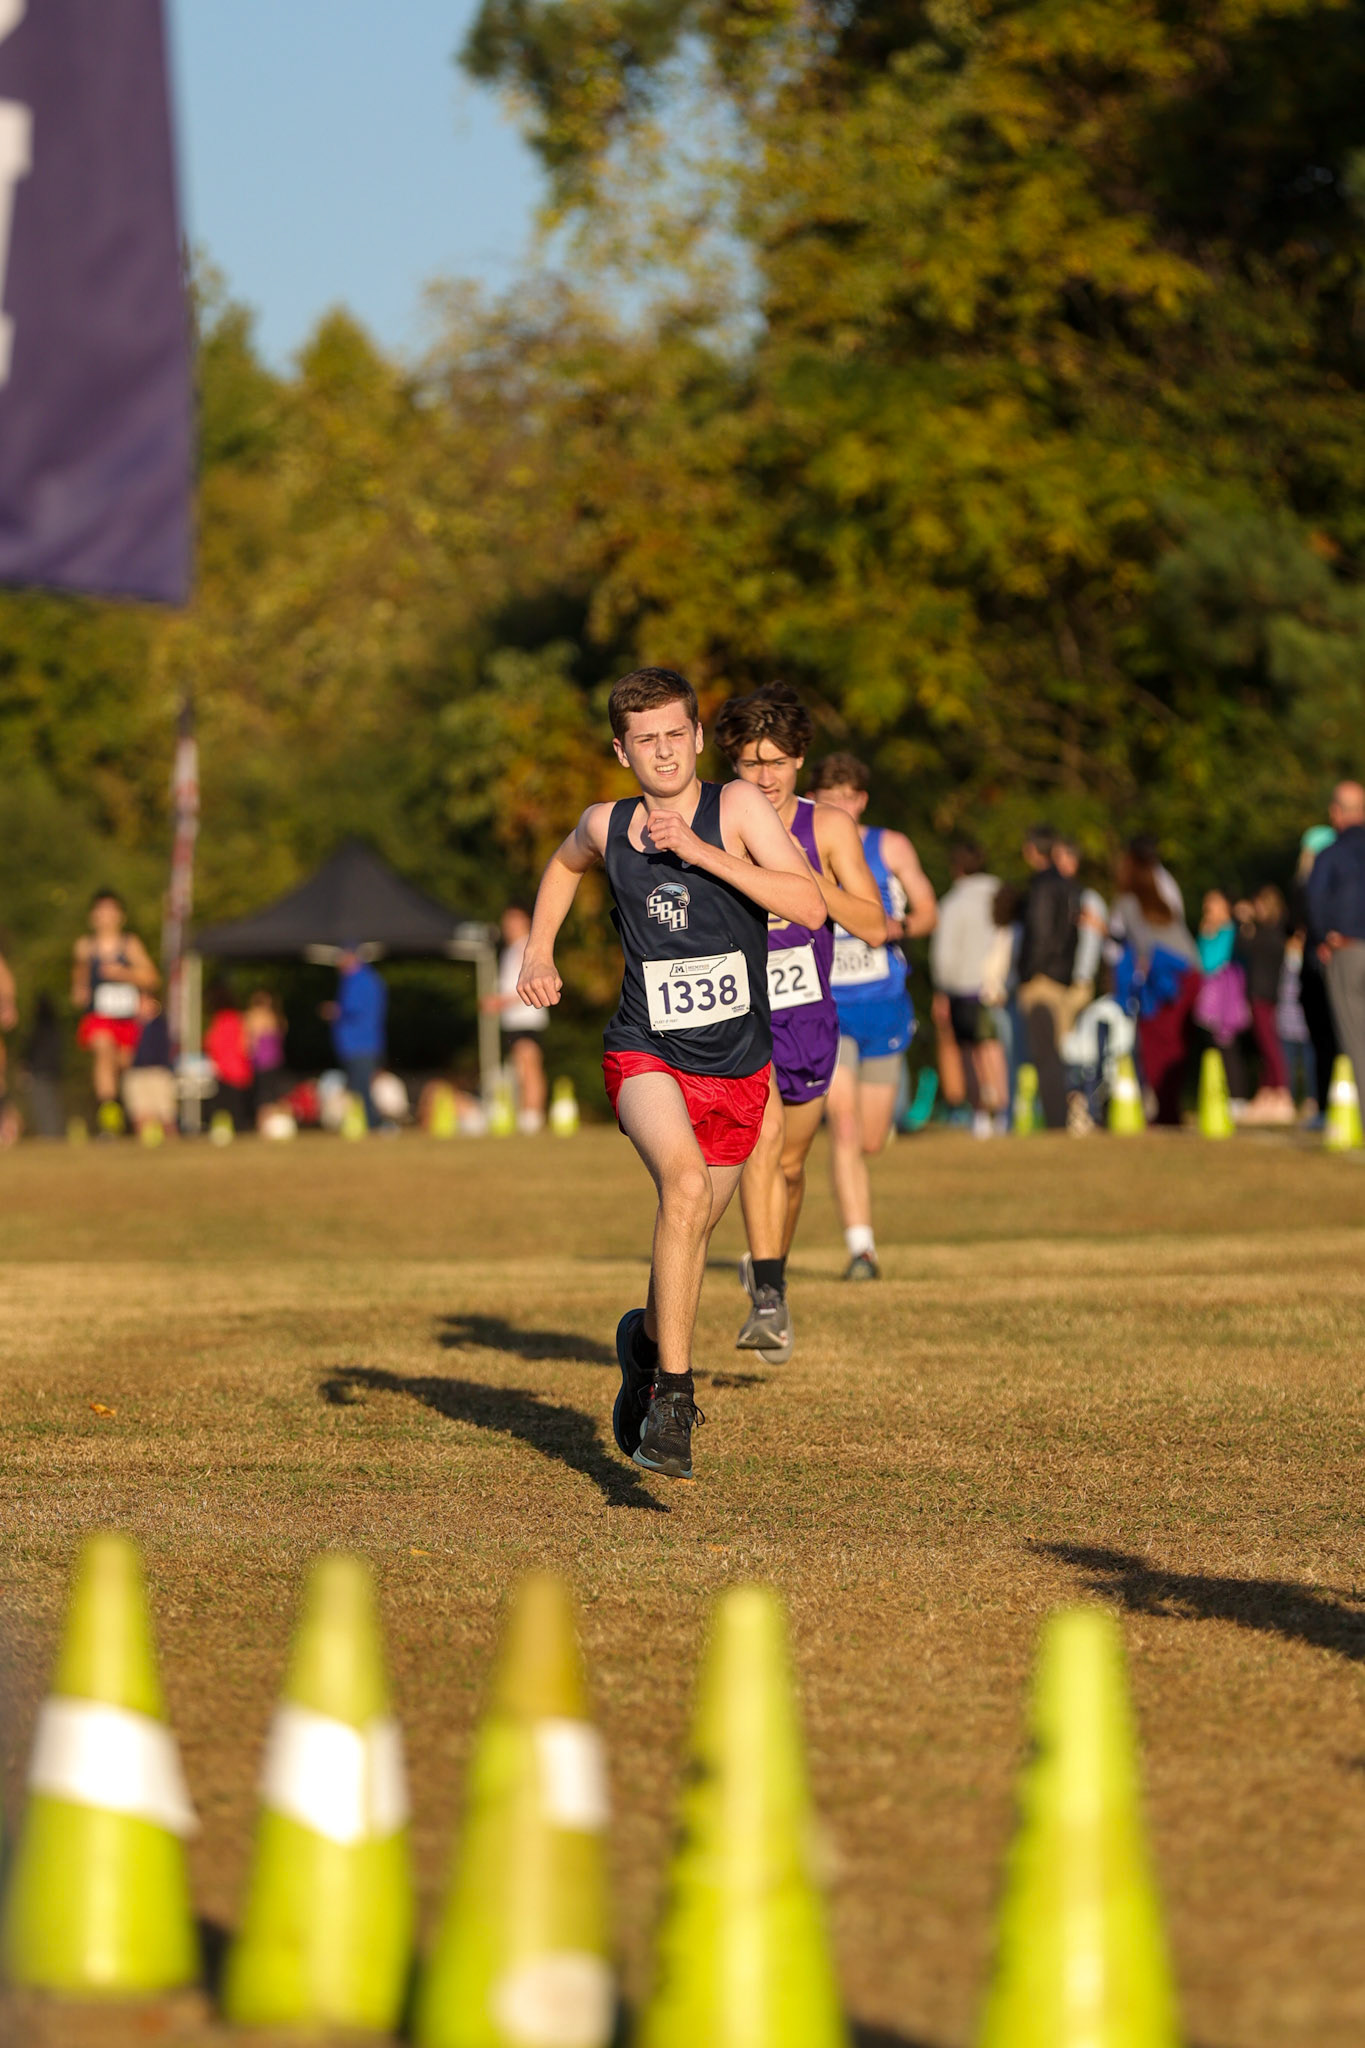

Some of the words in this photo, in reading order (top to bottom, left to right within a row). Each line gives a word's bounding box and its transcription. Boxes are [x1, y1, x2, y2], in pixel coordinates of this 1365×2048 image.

[649, 895, 686, 929] SBA
[658, 974, 738, 1015] 1338
[769, 965, 808, 995] 22
